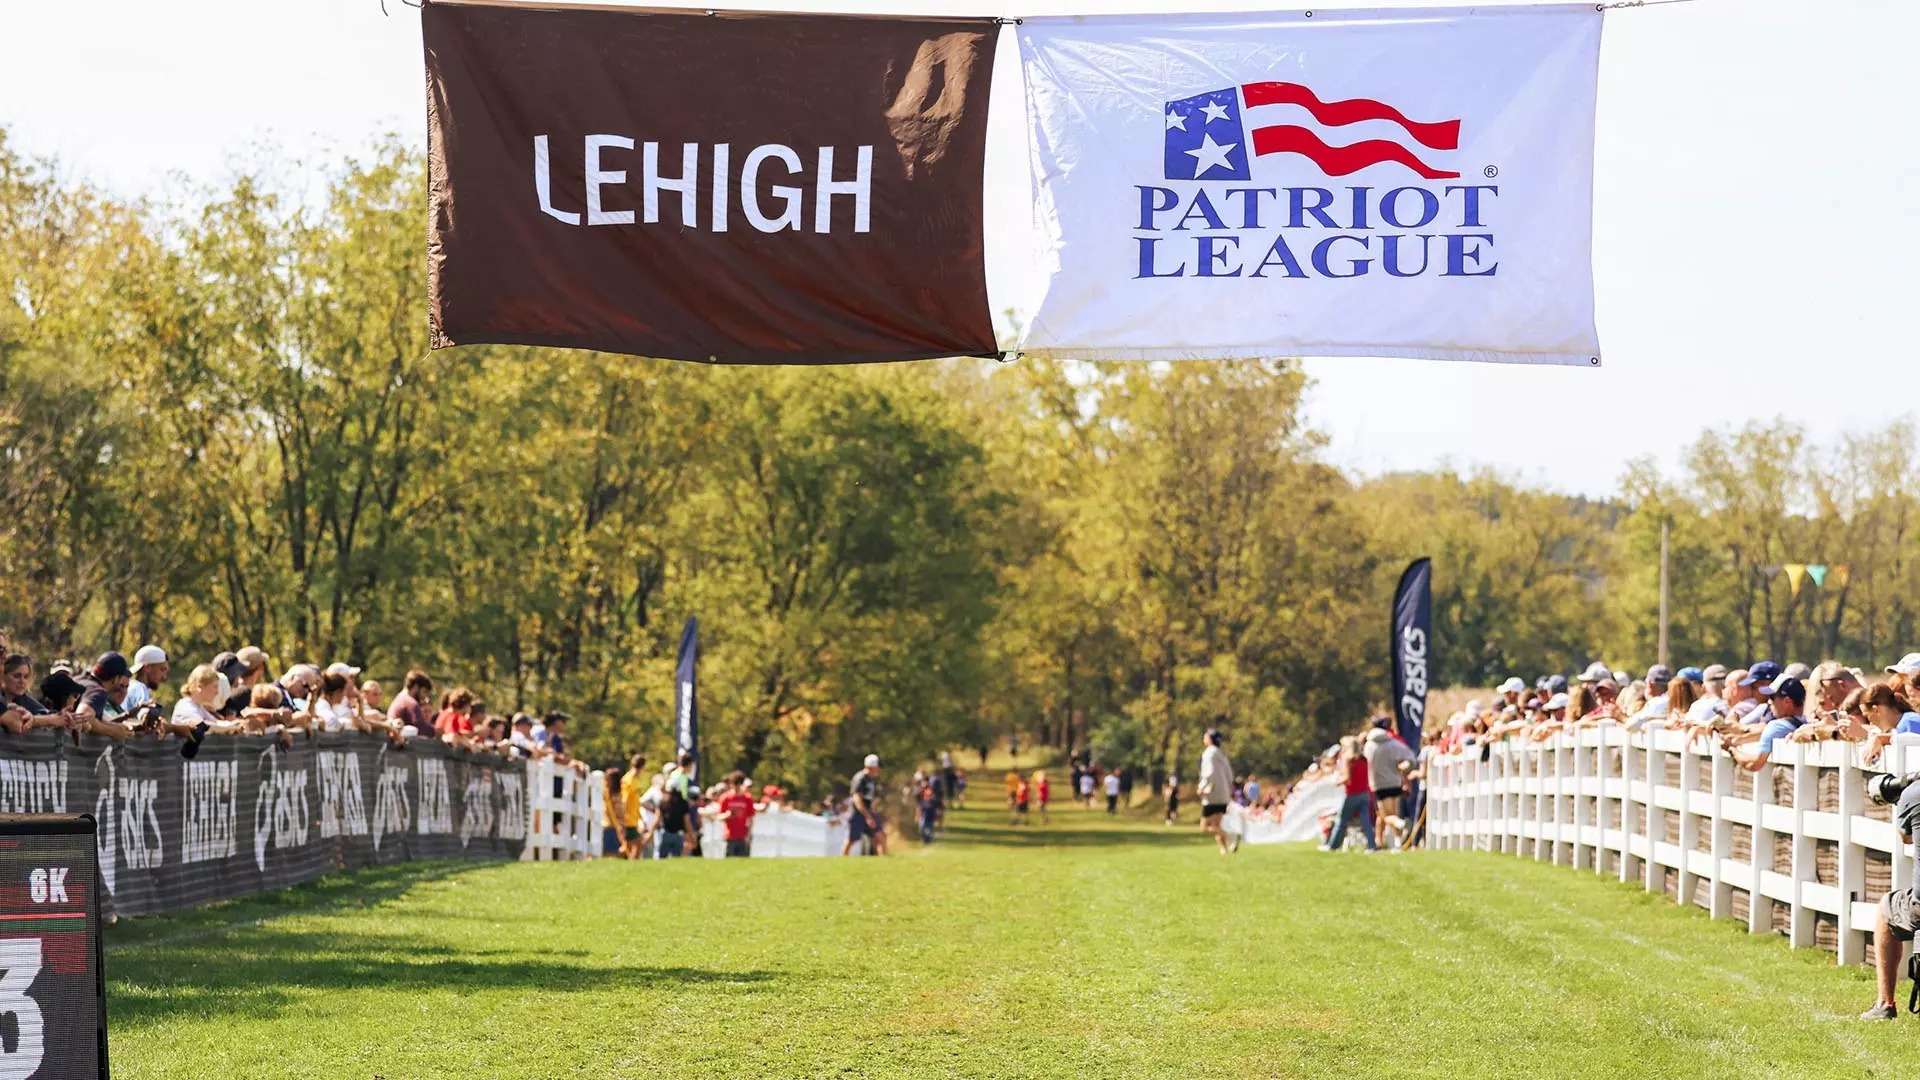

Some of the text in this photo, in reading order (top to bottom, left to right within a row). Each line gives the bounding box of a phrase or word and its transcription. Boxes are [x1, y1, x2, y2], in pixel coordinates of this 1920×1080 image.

[534, 134, 874, 233] LEHIGH
[1132, 185, 1499, 231] PATRIOT
[1131, 233, 1499, 280] LEAGUE
[29, 867, 70, 904] 6K
